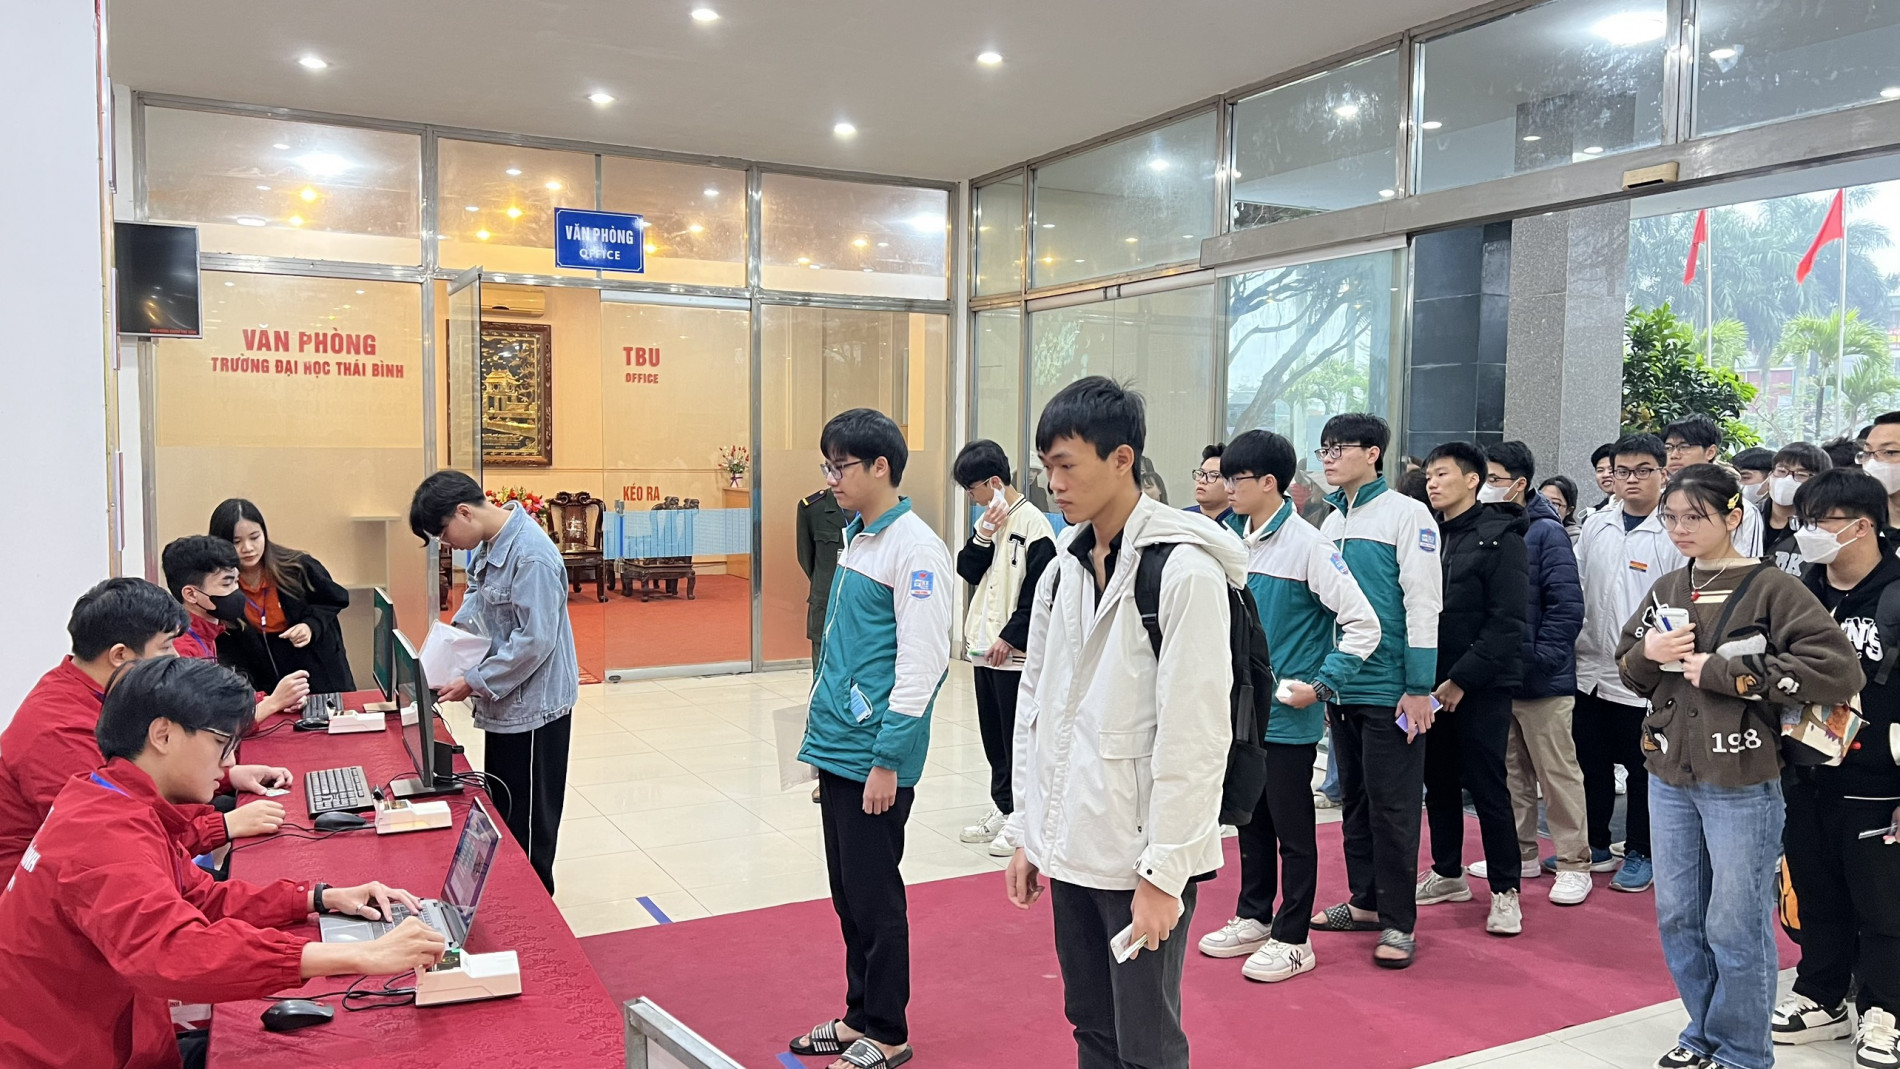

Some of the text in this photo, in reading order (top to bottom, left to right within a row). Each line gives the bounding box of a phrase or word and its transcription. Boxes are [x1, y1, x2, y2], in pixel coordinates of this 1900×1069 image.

[565, 223, 634, 245] VĂN PHÒNG
[579, 248, 621, 260] OFFICE
[298, 327, 377, 356] PHÒNG
[211, 353, 405, 378] TRƯỜNG ĐẠI HỌC THÁI BÌNH
[623, 346, 660, 368] TBU
[625, 372, 659, 384] OFFICE
[623, 483, 661, 501] KÉO RA
